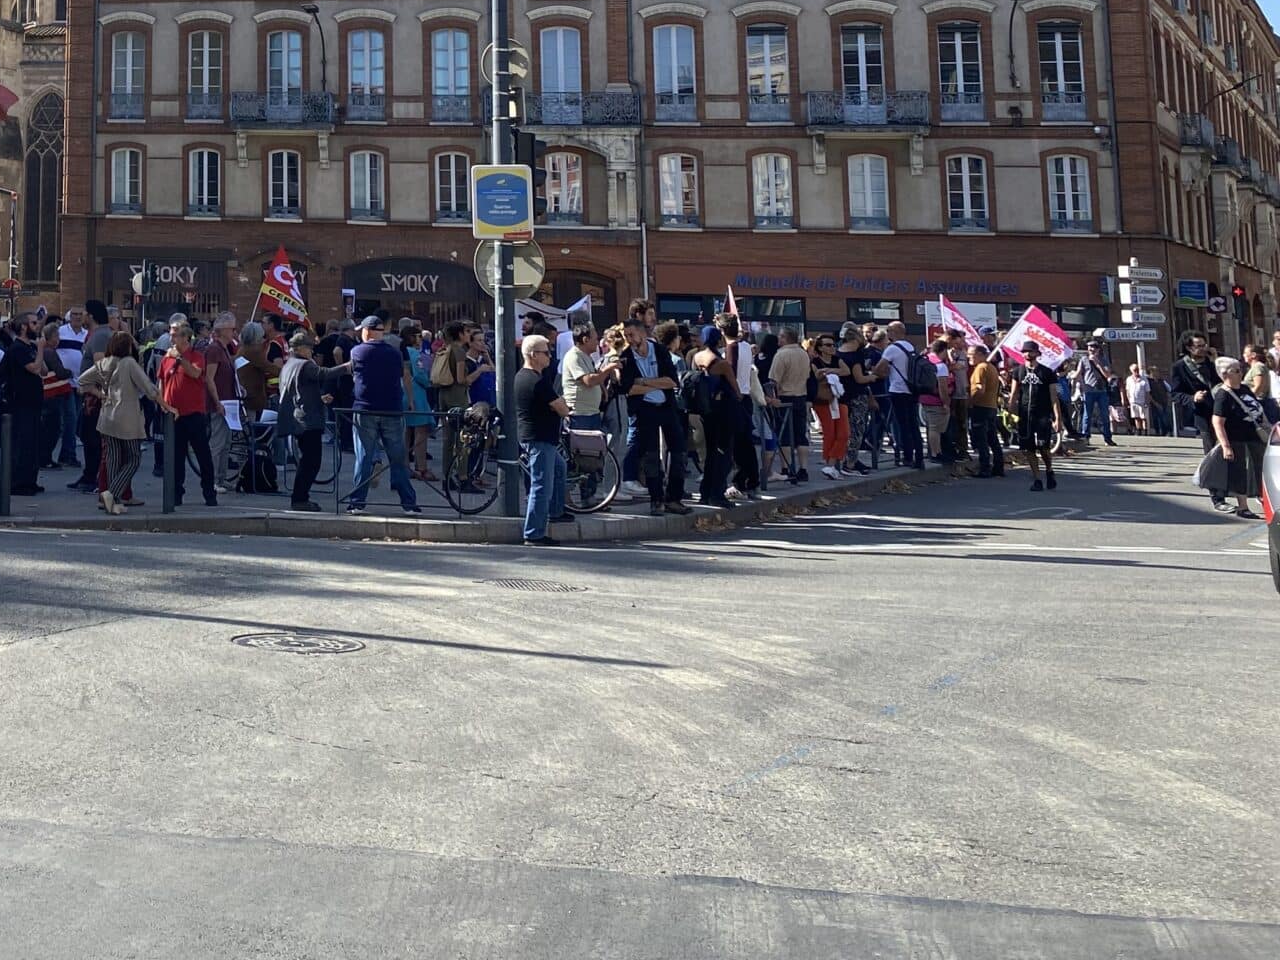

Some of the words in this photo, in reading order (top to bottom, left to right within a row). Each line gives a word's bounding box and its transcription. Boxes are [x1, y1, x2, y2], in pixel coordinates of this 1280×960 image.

[380, 273, 439, 293] SMOKY
[816, 272, 837, 290] de
[916, 279, 1019, 296] Assurances
